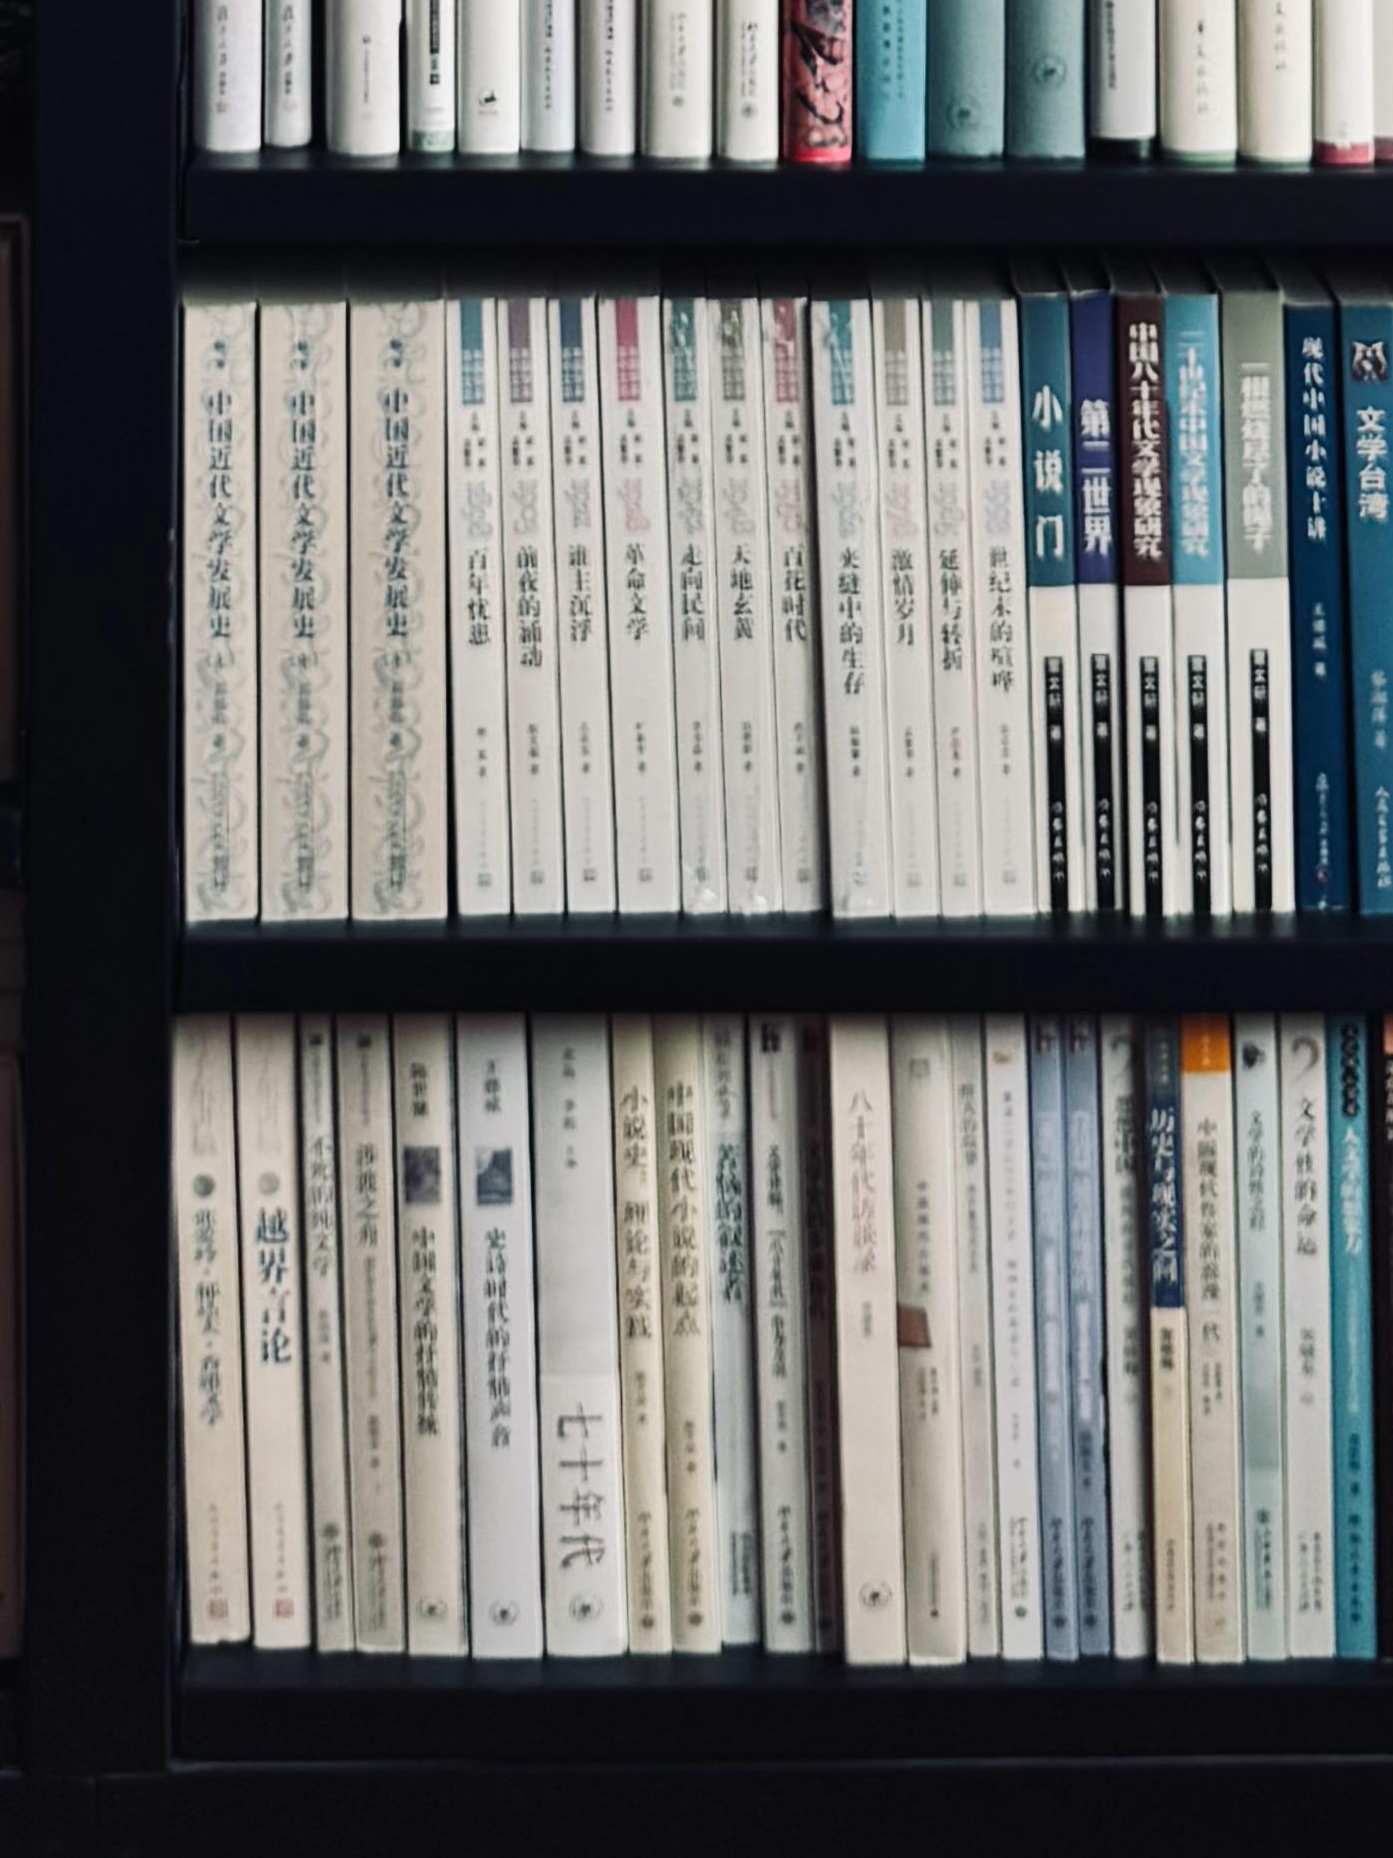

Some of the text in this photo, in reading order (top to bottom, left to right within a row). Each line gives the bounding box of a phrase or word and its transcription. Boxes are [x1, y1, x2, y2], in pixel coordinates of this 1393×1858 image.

[207, 391, 232, 639] 中国近代文学发展史
[1032, 384, 1064, 559] 小说门
[1079, 399, 1112, 553] 第二世界
[1302, 337, 1328, 543] 现代中国小说十讲
[1356, 406, 1389, 520] 文学台湾
[557, 1404, 607, 1569] 七十年代
